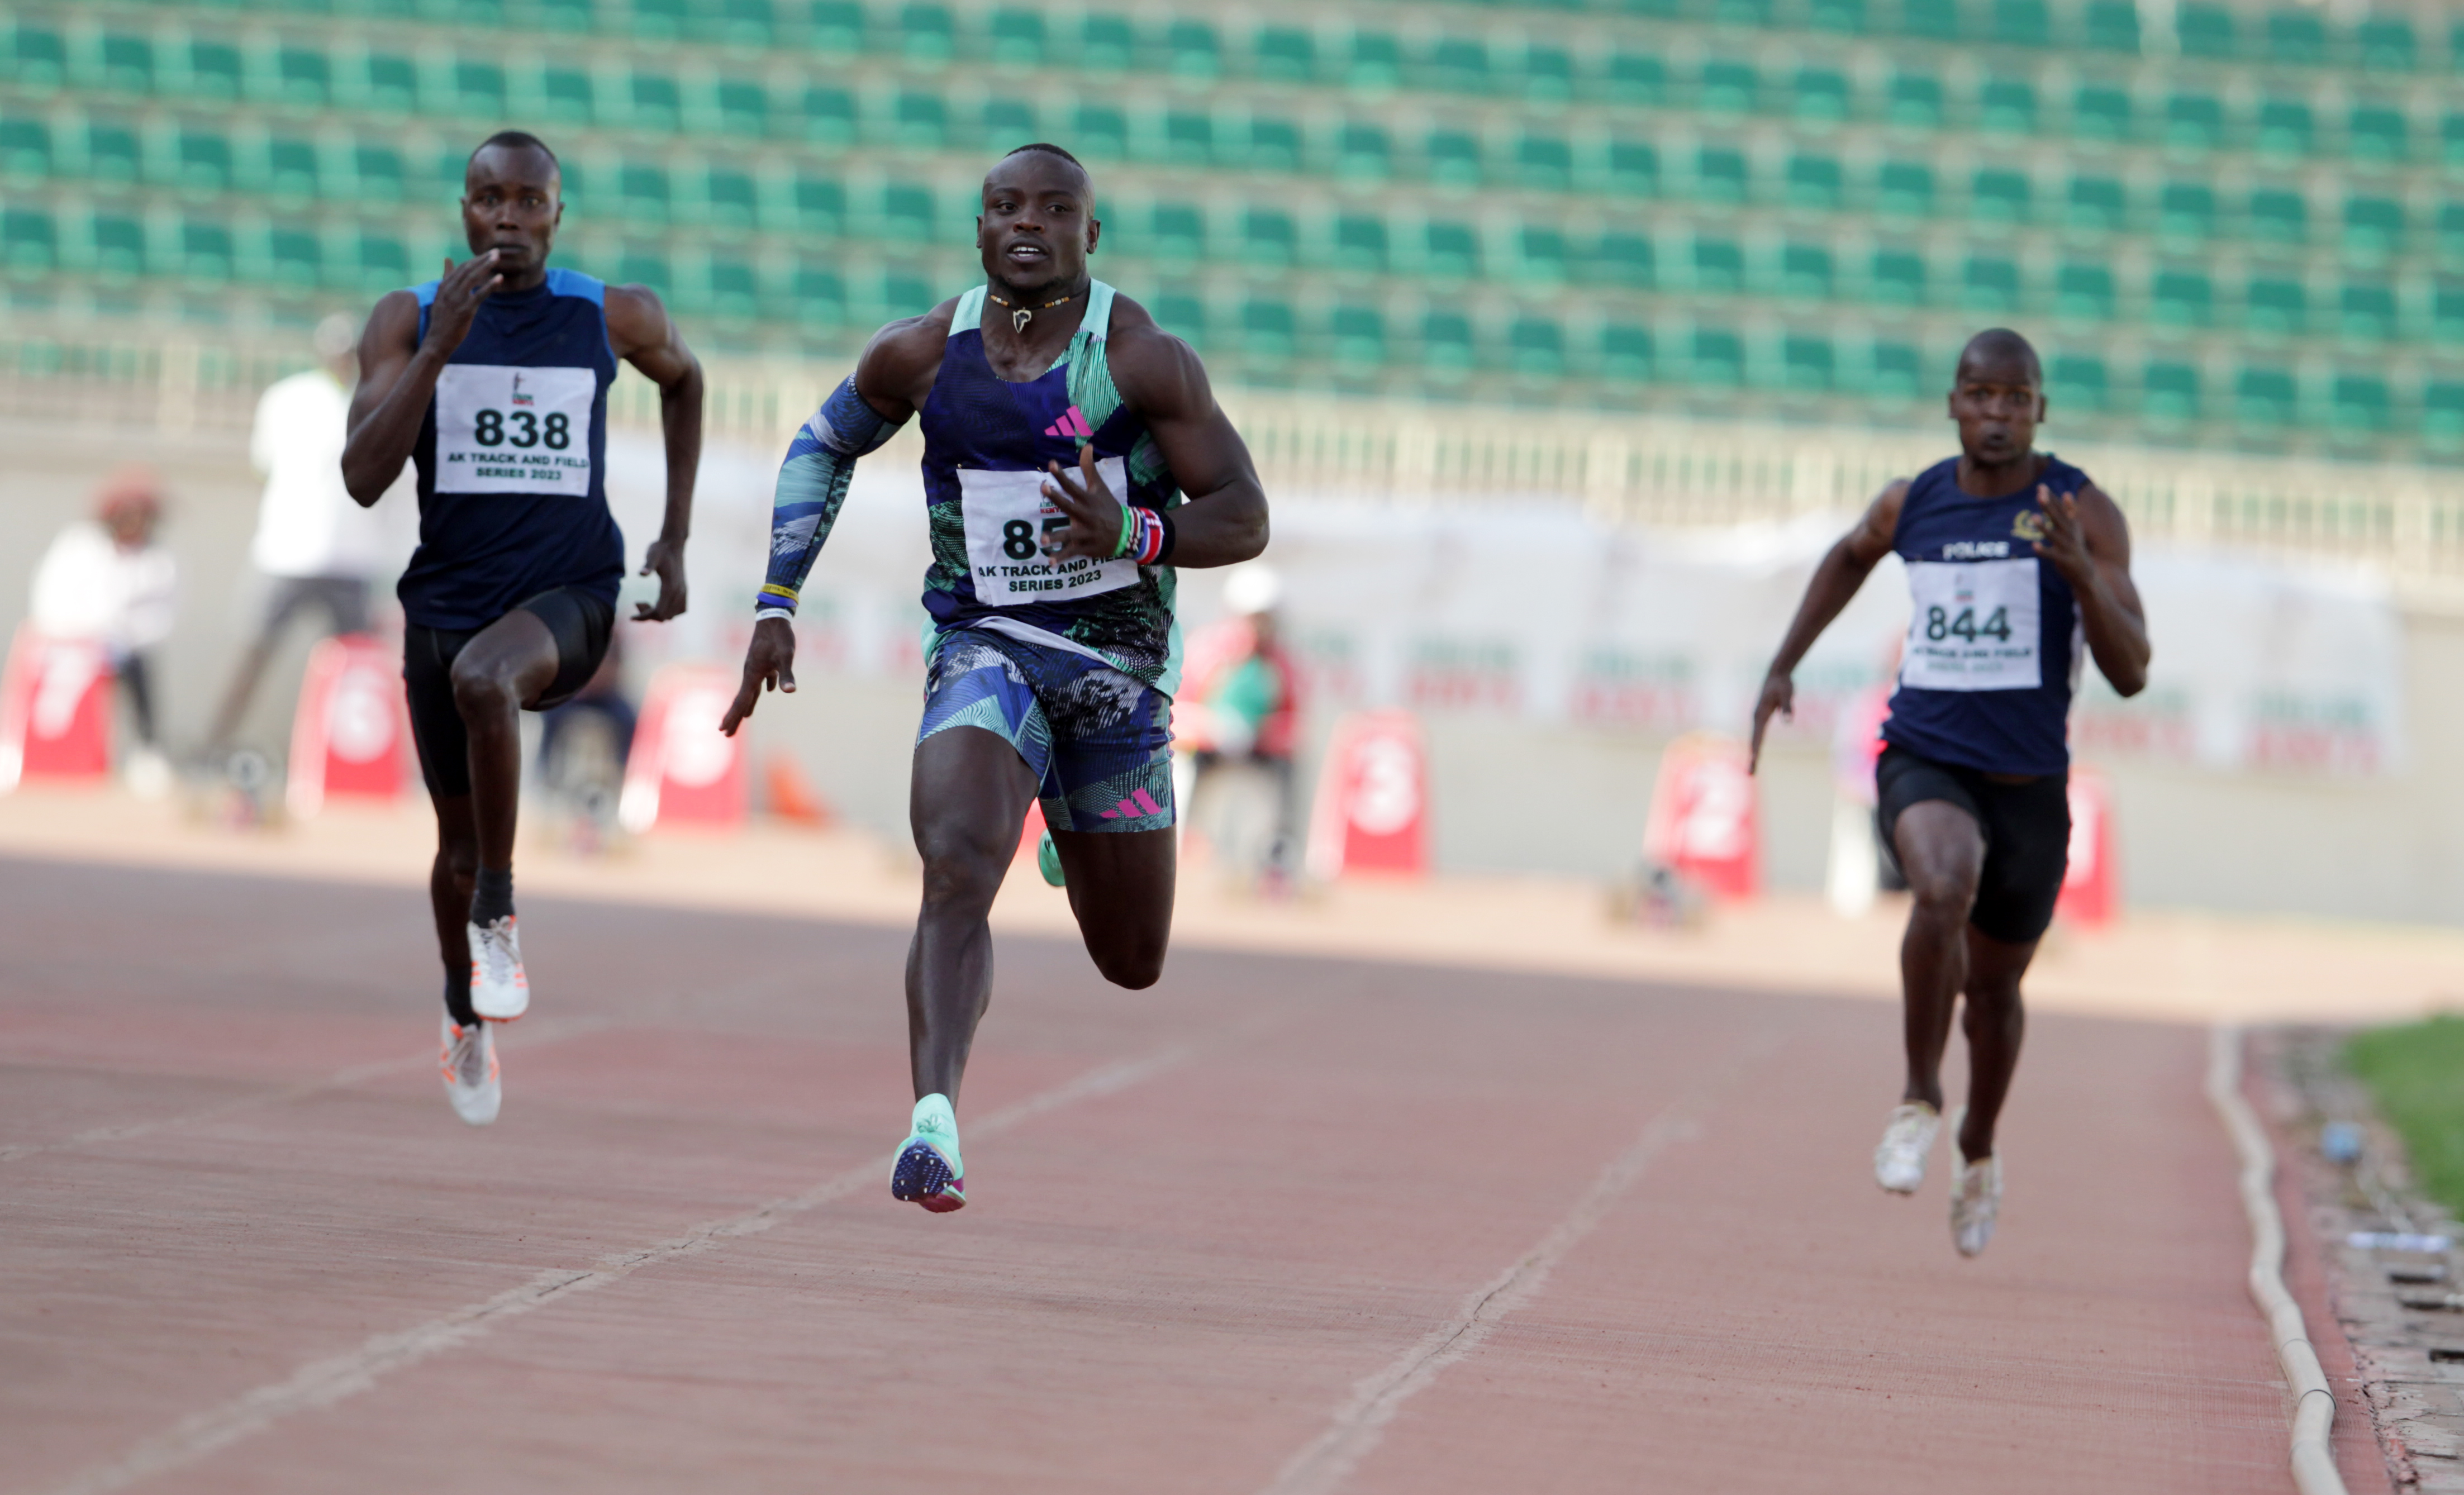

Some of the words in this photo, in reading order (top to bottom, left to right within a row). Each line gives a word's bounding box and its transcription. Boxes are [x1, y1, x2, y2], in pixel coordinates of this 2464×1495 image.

[474, 408, 570, 450] 838
[448, 452, 465, 462] AK
[471, 453, 517, 464] TRACK
[522, 455, 550, 465] AND
[477, 467, 526, 478] SERIES
[1003, 517, 1071, 560] 85
[1942, 541, 2010, 560] POLICE
[978, 566, 997, 577] AK
[1001, 565, 1053, 577] TRACK
[1057, 559, 1088, 575] AND
[1009, 579, 1064, 592] SERIES
[1068, 569, 1102, 588] 2023
[1927, 605, 2011, 642] 844
